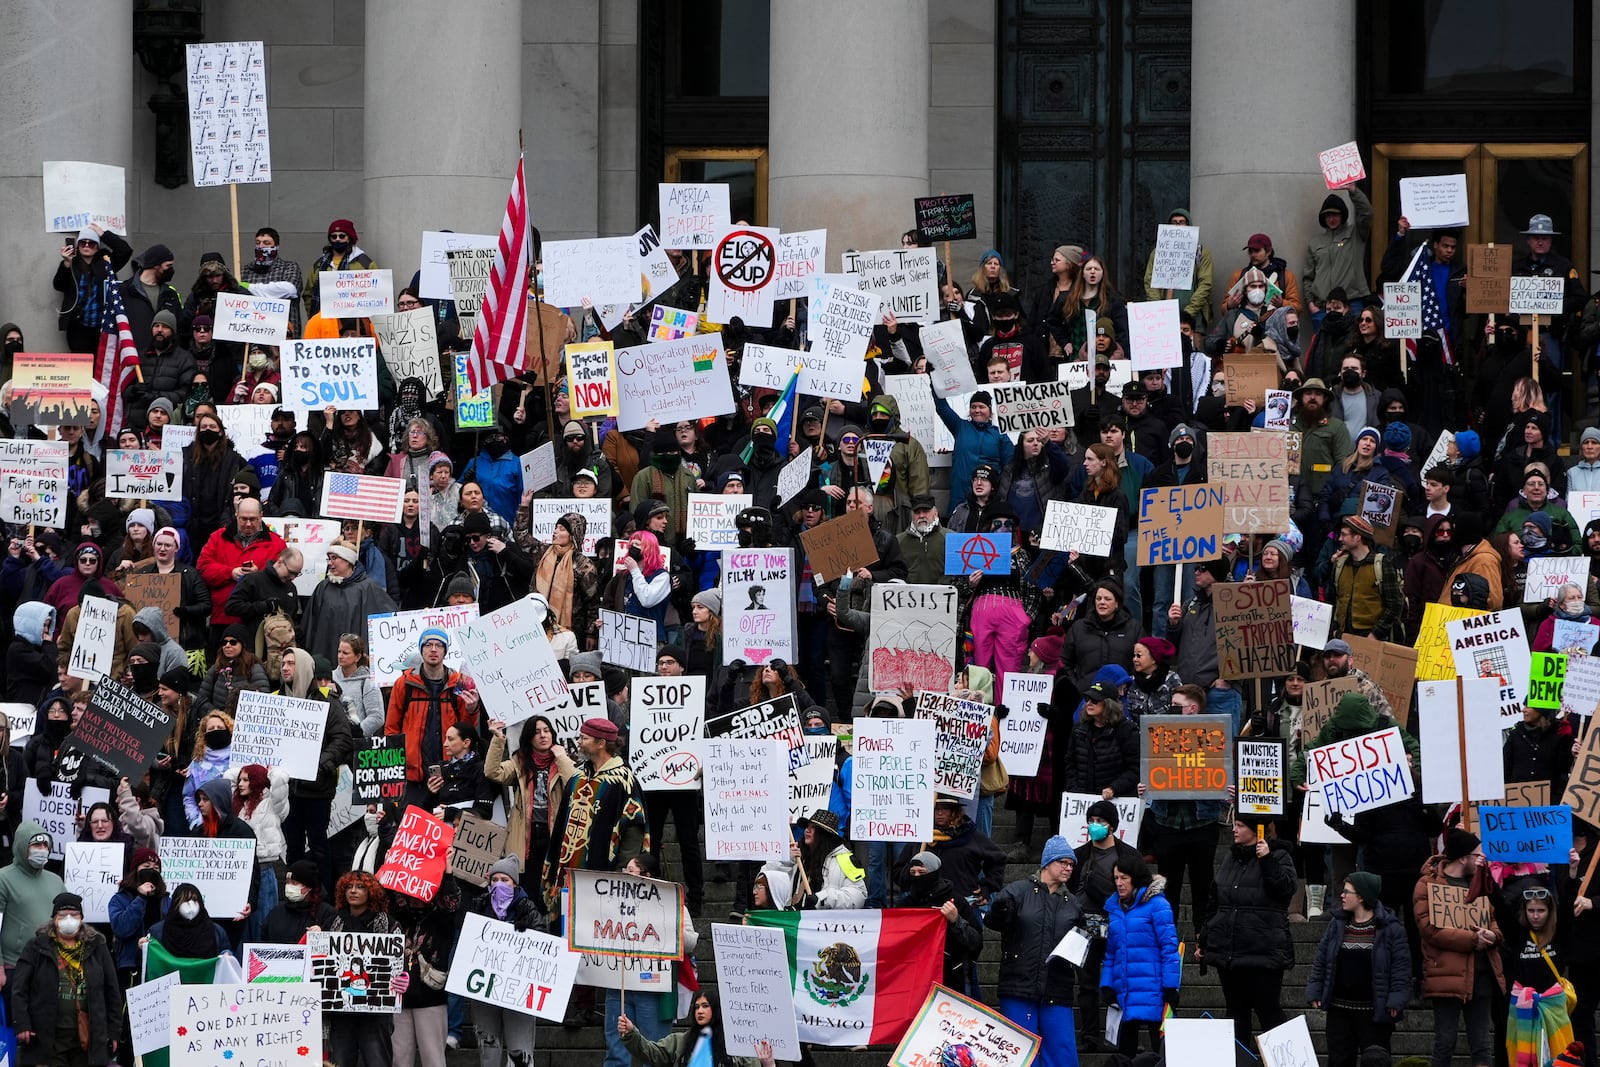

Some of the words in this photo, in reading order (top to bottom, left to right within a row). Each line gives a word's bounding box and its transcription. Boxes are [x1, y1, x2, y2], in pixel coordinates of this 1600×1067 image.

[1321, 148, 1357, 164] DEPOSE
[669, 188, 710, 206] AMERICA
[681, 205, 691, 214] IS
[920, 206, 950, 219] TRANS
[668, 216, 714, 234] EMPIRE
[722, 241, 770, 260] ELON
[721, 264, 764, 282] COUP
[832, 288, 870, 308] FASCISM
[1386, 285, 1404, 294] THERE
[1406, 285, 1418, 294] ARE
[225, 300, 248, 310] WHO
[254, 302, 284, 312] VOTED
[1396, 295, 1410, 303] NO
[654, 306, 696, 324] DUMP
[827, 302, 870, 323] REQUIRES
[386, 314, 412, 329] FUCK
[819, 313, 871, 338] COMPLIANCE
[1386, 317, 1417, 327] STOLEN
[823, 329, 850, 344] HOLD
[391, 346, 415, 362] FUCK
[824, 340, 843, 353] THE
[747, 346, 764, 359] ITS
[786, 355, 826, 371] PUNCH
[290, 366, 309, 378] TO
[321, 364, 360, 376] YOUR
[754, 362, 771, 373] OK
[765, 374, 780, 386] TO
[810, 379, 852, 394] NAZIS
[301, 382, 366, 405] SOUL
[575, 380, 612, 407] NOW
[994, 382, 1069, 404] DEMOCRACY
[459, 403, 490, 423] COUP
[1016, 402, 1046, 410] OVER
[999, 409, 1068, 434] DICTATOR!
[1215, 436, 1283, 459] NATO
[129, 465, 144, 473] ARE
[145, 465, 161, 473] NOT
[1211, 462, 1284, 480] PLEASE
[1367, 483, 1394, 498] MUZZLE
[535, 503, 584, 515] INTERNMENT
[590, 503, 608, 514] WAS
[693, 503, 721, 516] HATE
[1052, 502, 1069, 514] ITS
[1073, 506, 1085, 515] SO
[1091, 507, 1107, 518] BAD
[693, 518, 712, 529] NOT
[1053, 515, 1078, 527] EVEN
[1083, 516, 1100, 529] THE
[693, 531, 708, 543] US
[1046, 526, 1112, 546] INTROVERTS
[1143, 527, 1167, 541] THE
[1150, 535, 1216, 564] FELON
[730, 554, 759, 569] KEEP
[763, 554, 787, 568] YOUR
[1545, 575, 1568, 585] YOUR
[884, 590, 955, 614] RESIST
[1235, 580, 1288, 610] STOP
[740, 614, 776, 635] OFF
[1463, 613, 1501, 630] MAKE
[83, 623, 106, 643] FOR
[1455, 627, 1519, 650] AMERICA
[72, 646, 101, 673] ALL
[642, 684, 692, 706] STOP
[1011, 680, 1047, 693] TRUMP
[96, 685, 109, 698] NO
[109, 692, 123, 706] TE
[120, 699, 146, 722] NUBLE
[143, 715, 155, 728] LA
[102, 676, 119, 690] QUE
[120, 687, 132, 698] EL
[128, 692, 169, 724] PRIVILEGIO
[242, 692, 285, 707] PRIVILEGE
[287, 699, 295, 707] IS
[296, 701, 323, 712] WHEN
[1022, 700, 1031, 712] IS
[239, 704, 256, 715] YOU
[258, 707, 286, 718] THINK
[651, 712, 673, 724] THE
[732, 704, 775, 731] STOP
[84, 711, 102, 725] MAY
[103, 721, 141, 749] PRIVILEGE
[236, 714, 289, 727] SOMETHING
[290, 719, 299, 728] IS
[300, 721, 320, 731] NOT
[640, 717, 698, 744] COUP!
[883, 721, 904, 735] THE
[1007, 720, 1041, 732] ELONS
[74, 729, 111, 754] EMPATHY
[235, 724, 241, 732] A
[243, 724, 281, 736] PROBLEM
[283, 728, 320, 742] BECAUSE
[1148, 726, 1225, 753] YEETO
[80, 721, 98, 737] NOT
[98, 728, 125, 751] CLOUD
[125, 747, 144, 763] YOUR
[232, 743, 273, 756] AFFECTED
[859, 737, 893, 752] POWER
[910, 741, 921, 752] OF
[1242, 744, 1278, 757] INJUSTICE
[358, 749, 405, 768] SPEAKING
[632, 749, 644, 763] NO
[650, 746, 677, 761] VOTED
[1173, 752, 1206, 767] THE
[1314, 732, 1394, 782] RESIST
[858, 757, 873, 769] THE
[879, 757, 912, 771] PEOPLE
[919, 759, 928, 769] IS
[1242, 758, 1278, 768] ANYWHERE
[356, 767, 375, 782] FOR
[377, 766, 404, 781] THOSE
[856, 775, 927, 790] STRONGER
[1150, 767, 1226, 790] CHEETO
[1241, 778, 1278, 793] JUSTICE
[1324, 763, 1408, 813] FASCISM
[719, 790, 769, 799] CRIMINALS
[872, 794, 892, 806] THAN
[900, 793, 914, 805] THE
[855, 808, 887, 821] PEOPLE
[906, 808, 920, 819] IN
[1486, 812, 1516, 831] DEI
[1525, 810, 1567, 829] HURTS
[869, 822, 918, 837] POWER!
[161, 839, 170, 847] IF
[172, 839, 191, 848] YOU
[192, 839, 209, 848] ARE
[212, 839, 254, 849] NEUTRAL
[71, 846, 112, 866] WE
[160, 848, 168, 856] IN
[169, 849, 223, 859] SITUATIONS
[225, 850, 237, 858] OF
[66, 869, 93, 883] ARE
[100, 871, 119, 884] THE
[196, 871, 213, 880] THE
[217, 872, 237, 880] SIDE
[594, 879, 661, 901] CHINGA
[1432, 904, 1490, 928] FACISM
[593, 918, 660, 941] MAGA
[330, 934, 353, 956] NO
[472, 945, 509, 972] MAKE
[512, 953, 558, 985] AMERICA
[466, 969, 552, 1012] GREAT
[196, 1020, 221, 1032] ONE
[226, 1014, 248, 1029] DAY
[251, 1013, 258, 1026] I
[263, 1012, 290, 1024] HAVE
[800, 1014, 865, 1030] MEXICO
[188, 1040, 202, 1052] AS
[214, 1036, 248, 1050] MANY
[257, 1030, 302, 1047] RIGHTS
